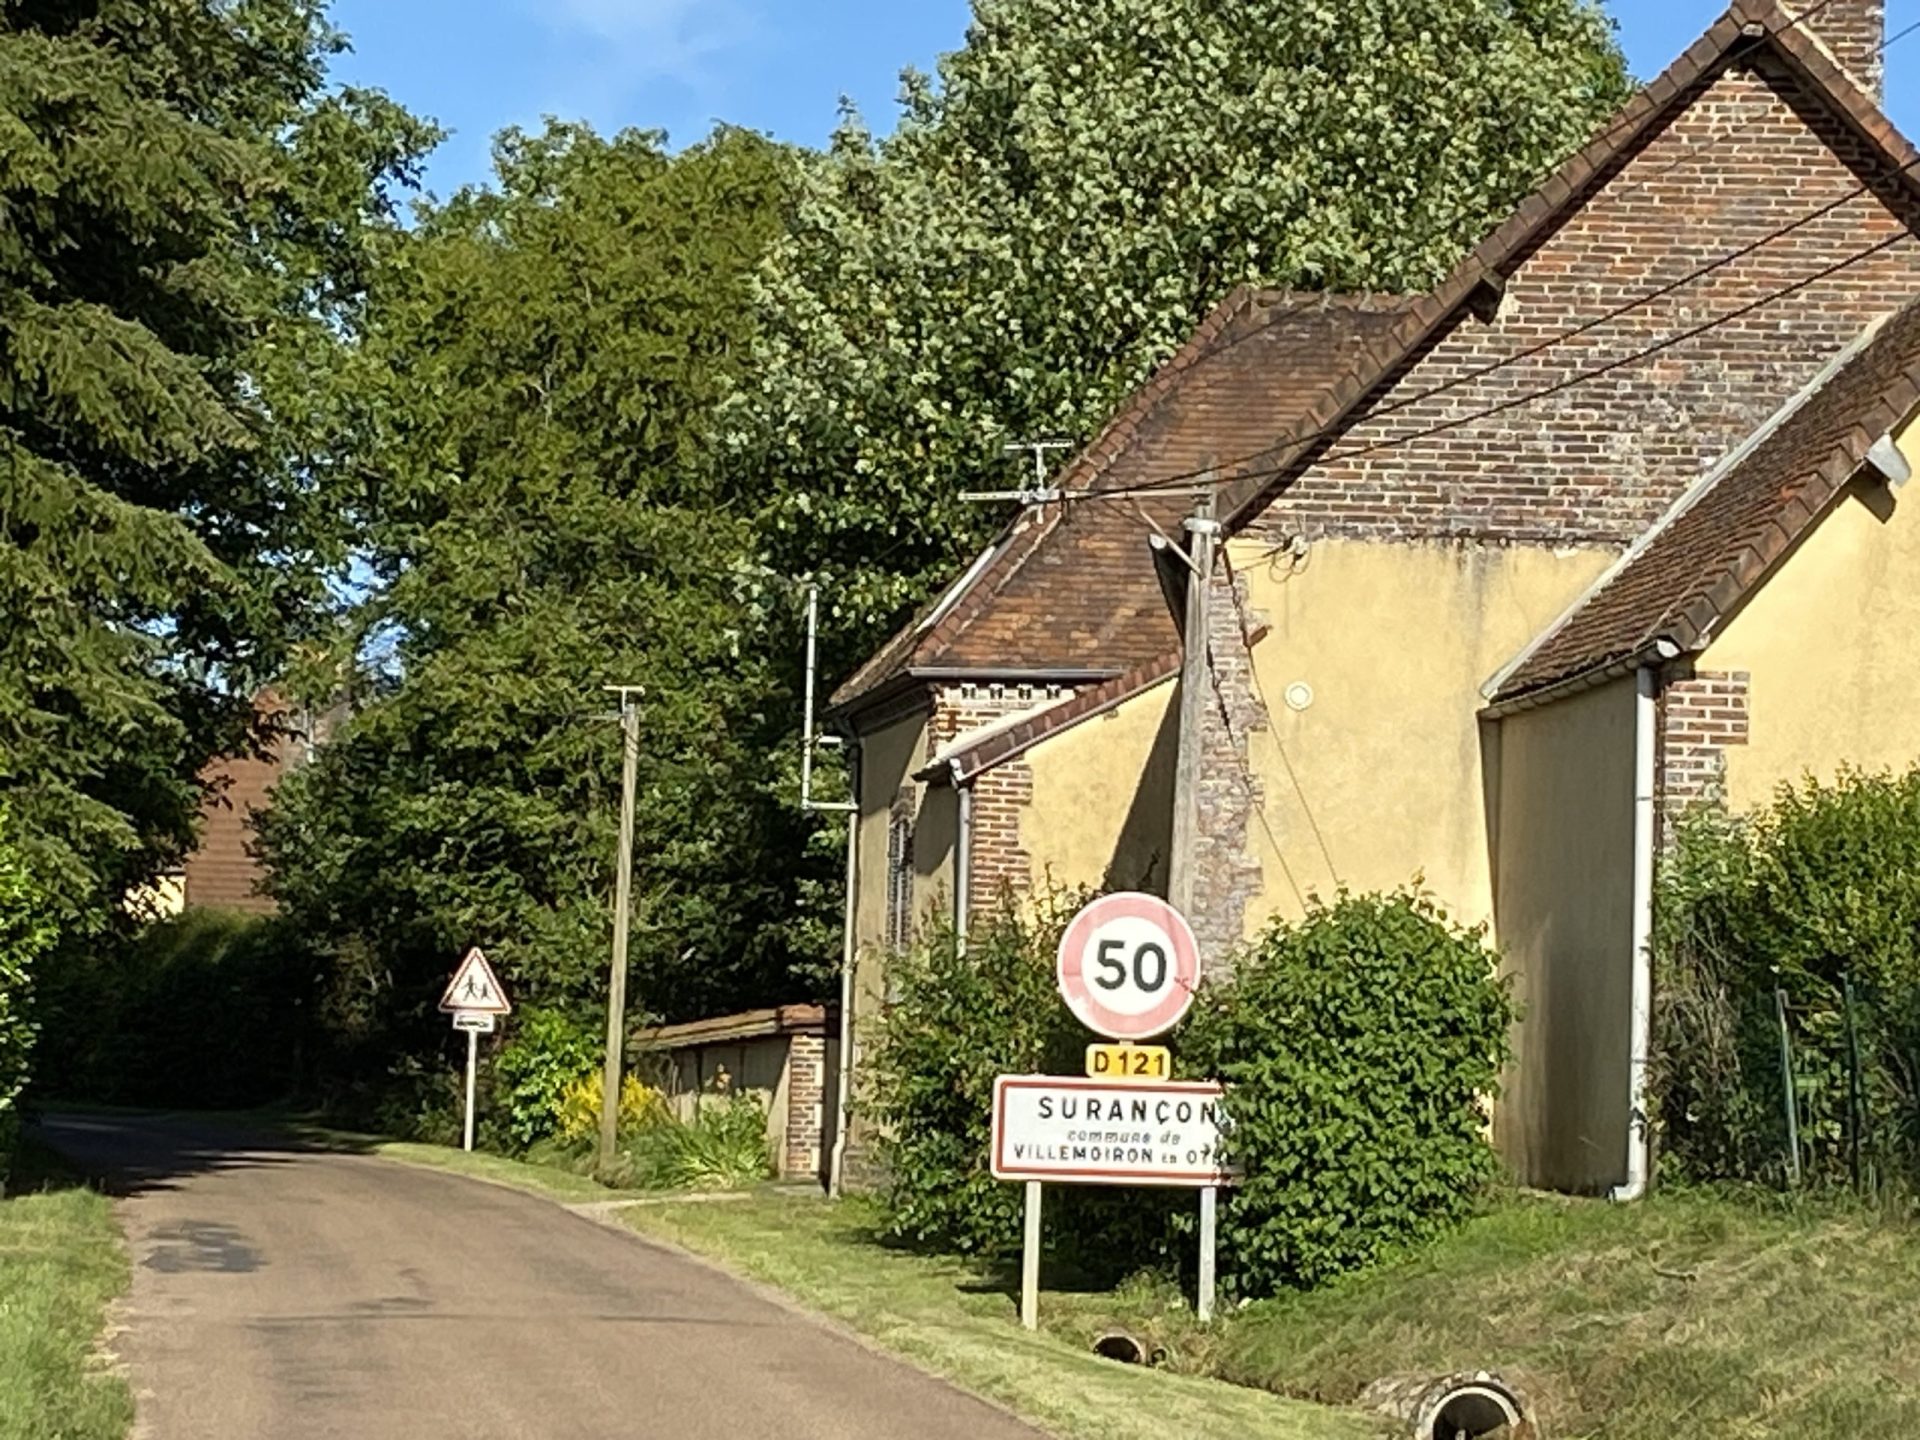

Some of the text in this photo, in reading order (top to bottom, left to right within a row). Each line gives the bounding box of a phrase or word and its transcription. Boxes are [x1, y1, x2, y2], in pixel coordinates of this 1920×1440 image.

[1095, 939, 1167, 993] 50
[1094, 1051, 1164, 1076] D 121
[1038, 1096, 1216, 1125] SURANÇON
[1067, 1130, 1181, 1145] commune de
[1014, 1144, 1153, 1163] VILLEMOIRON
